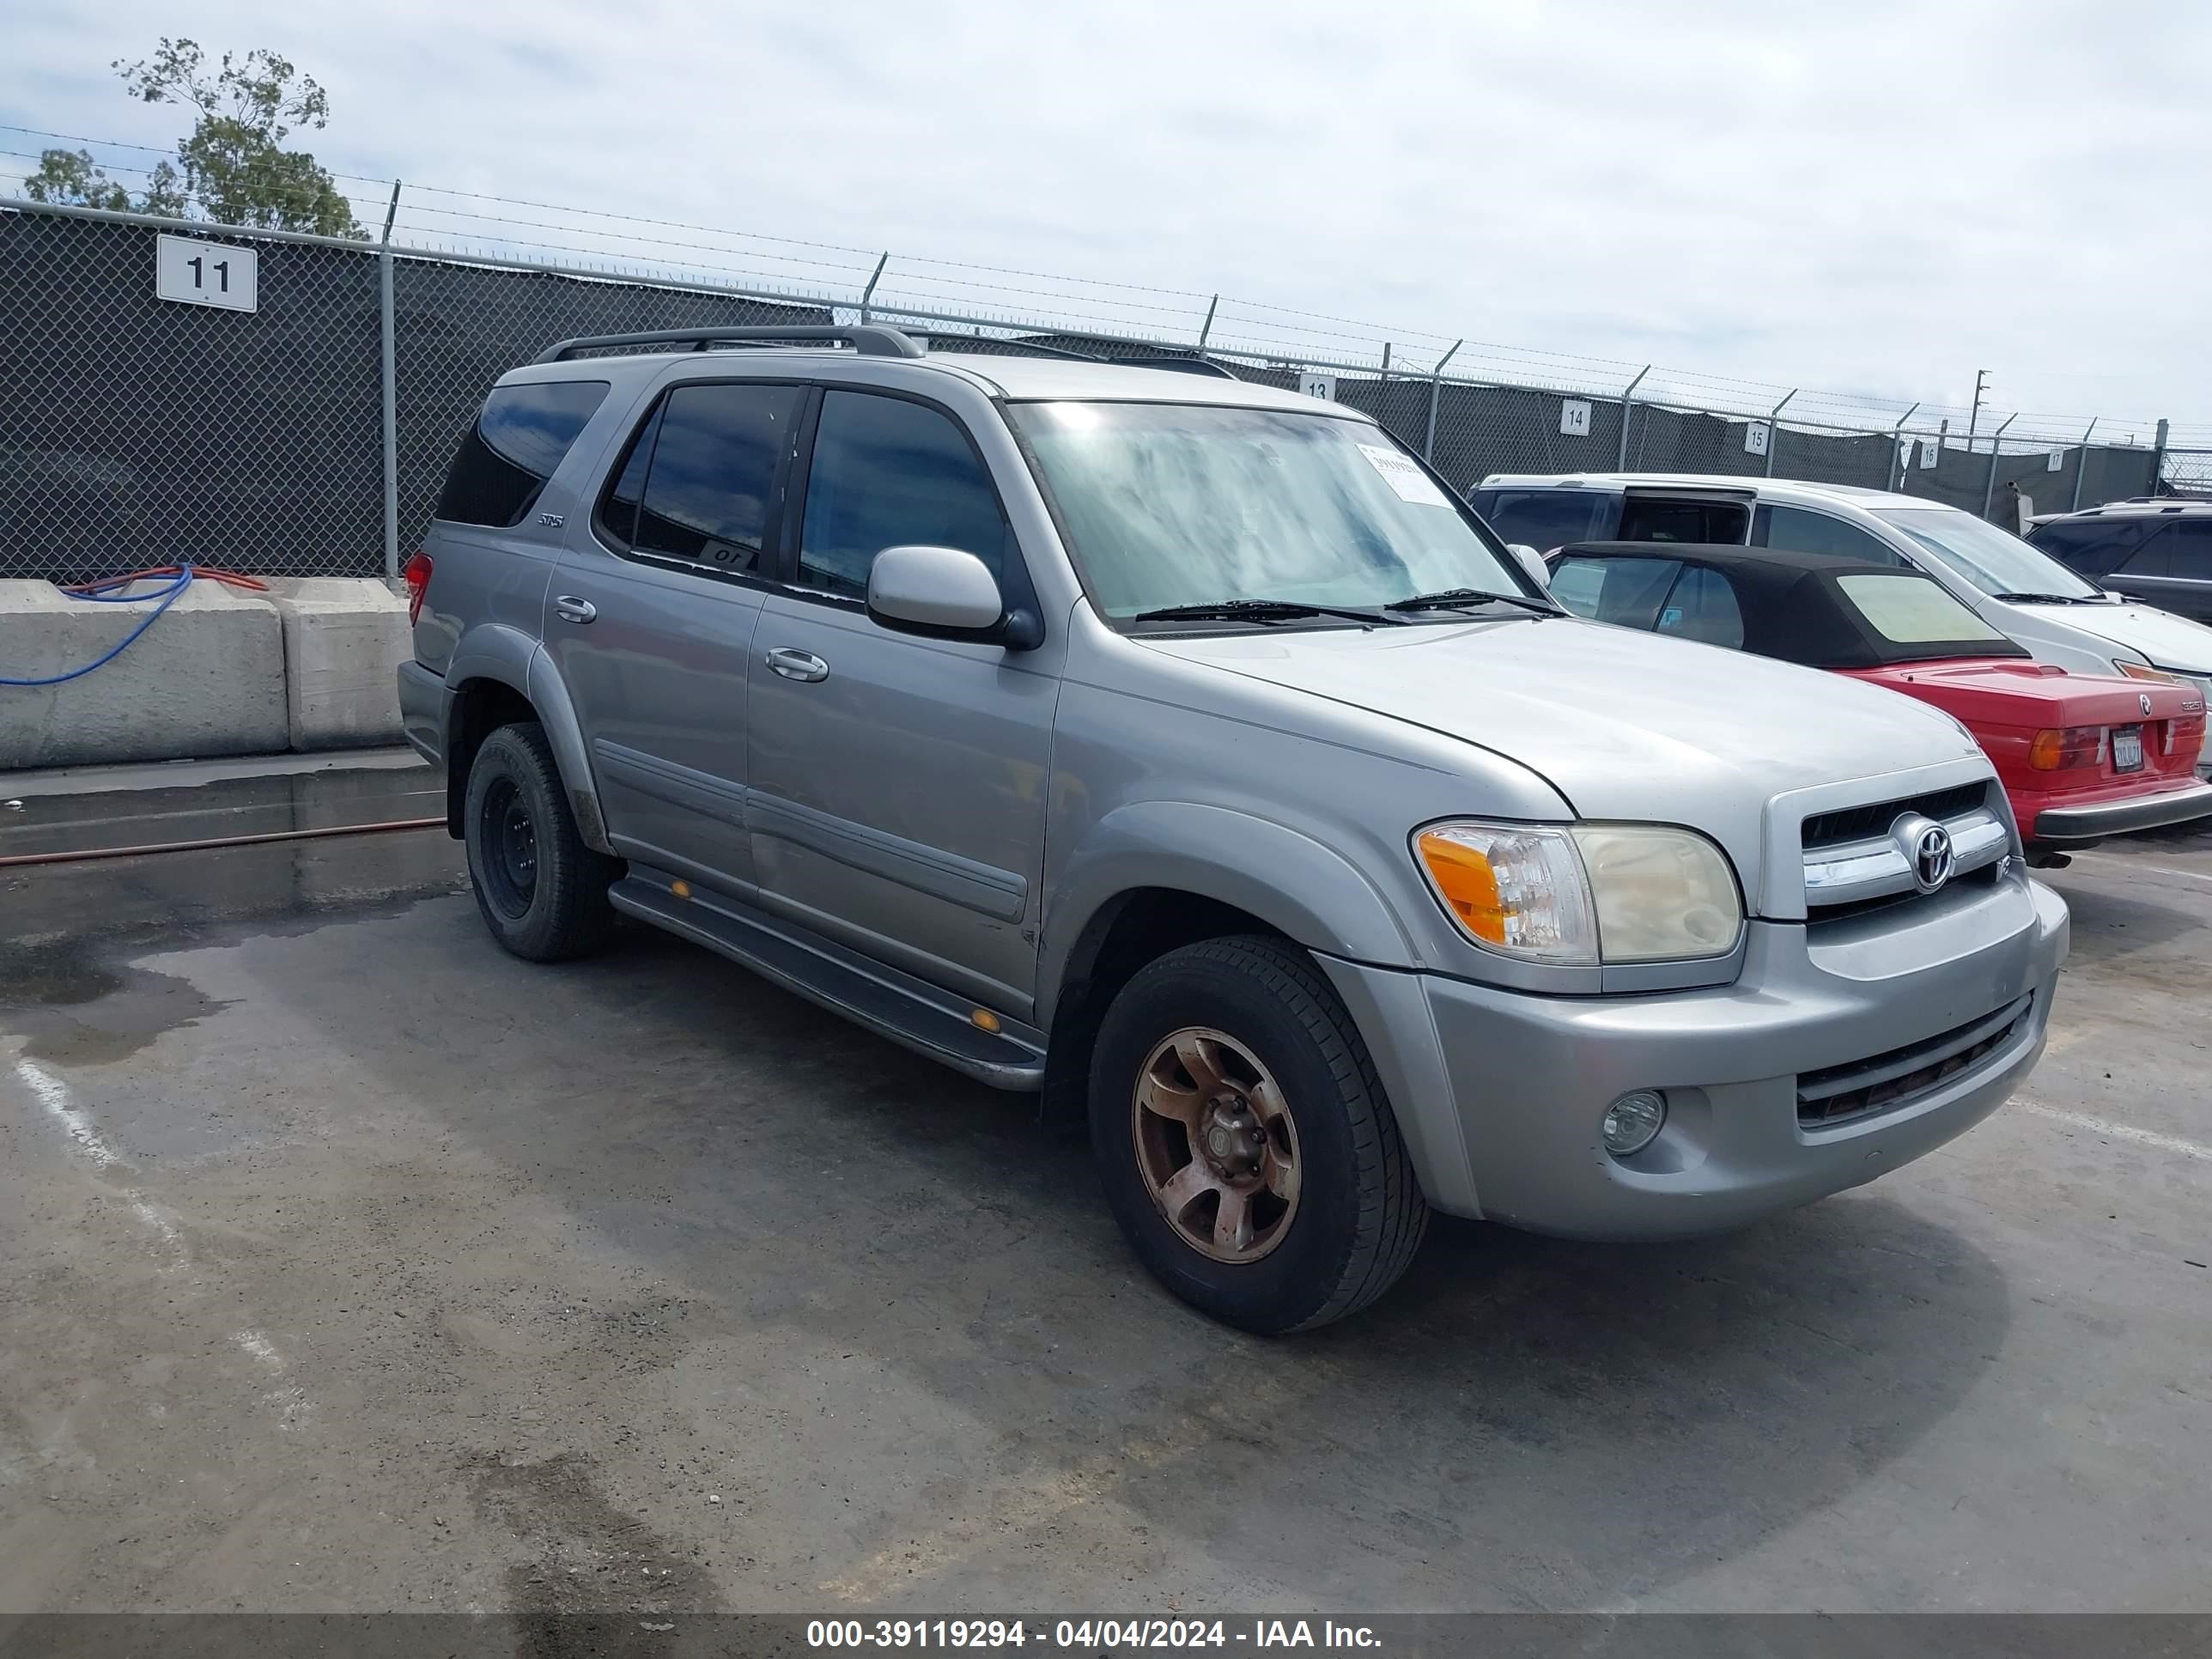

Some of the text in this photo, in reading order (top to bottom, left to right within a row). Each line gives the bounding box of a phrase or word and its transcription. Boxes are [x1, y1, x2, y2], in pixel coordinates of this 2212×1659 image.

[187, 257, 228, 293] 11
[1310, 383, 1326, 399] 13
[1570, 410, 1583, 427] 14
[1752, 431, 1763, 447] 15
[1926, 449, 1934, 462] 16
[2053, 454, 2060, 465] 17
